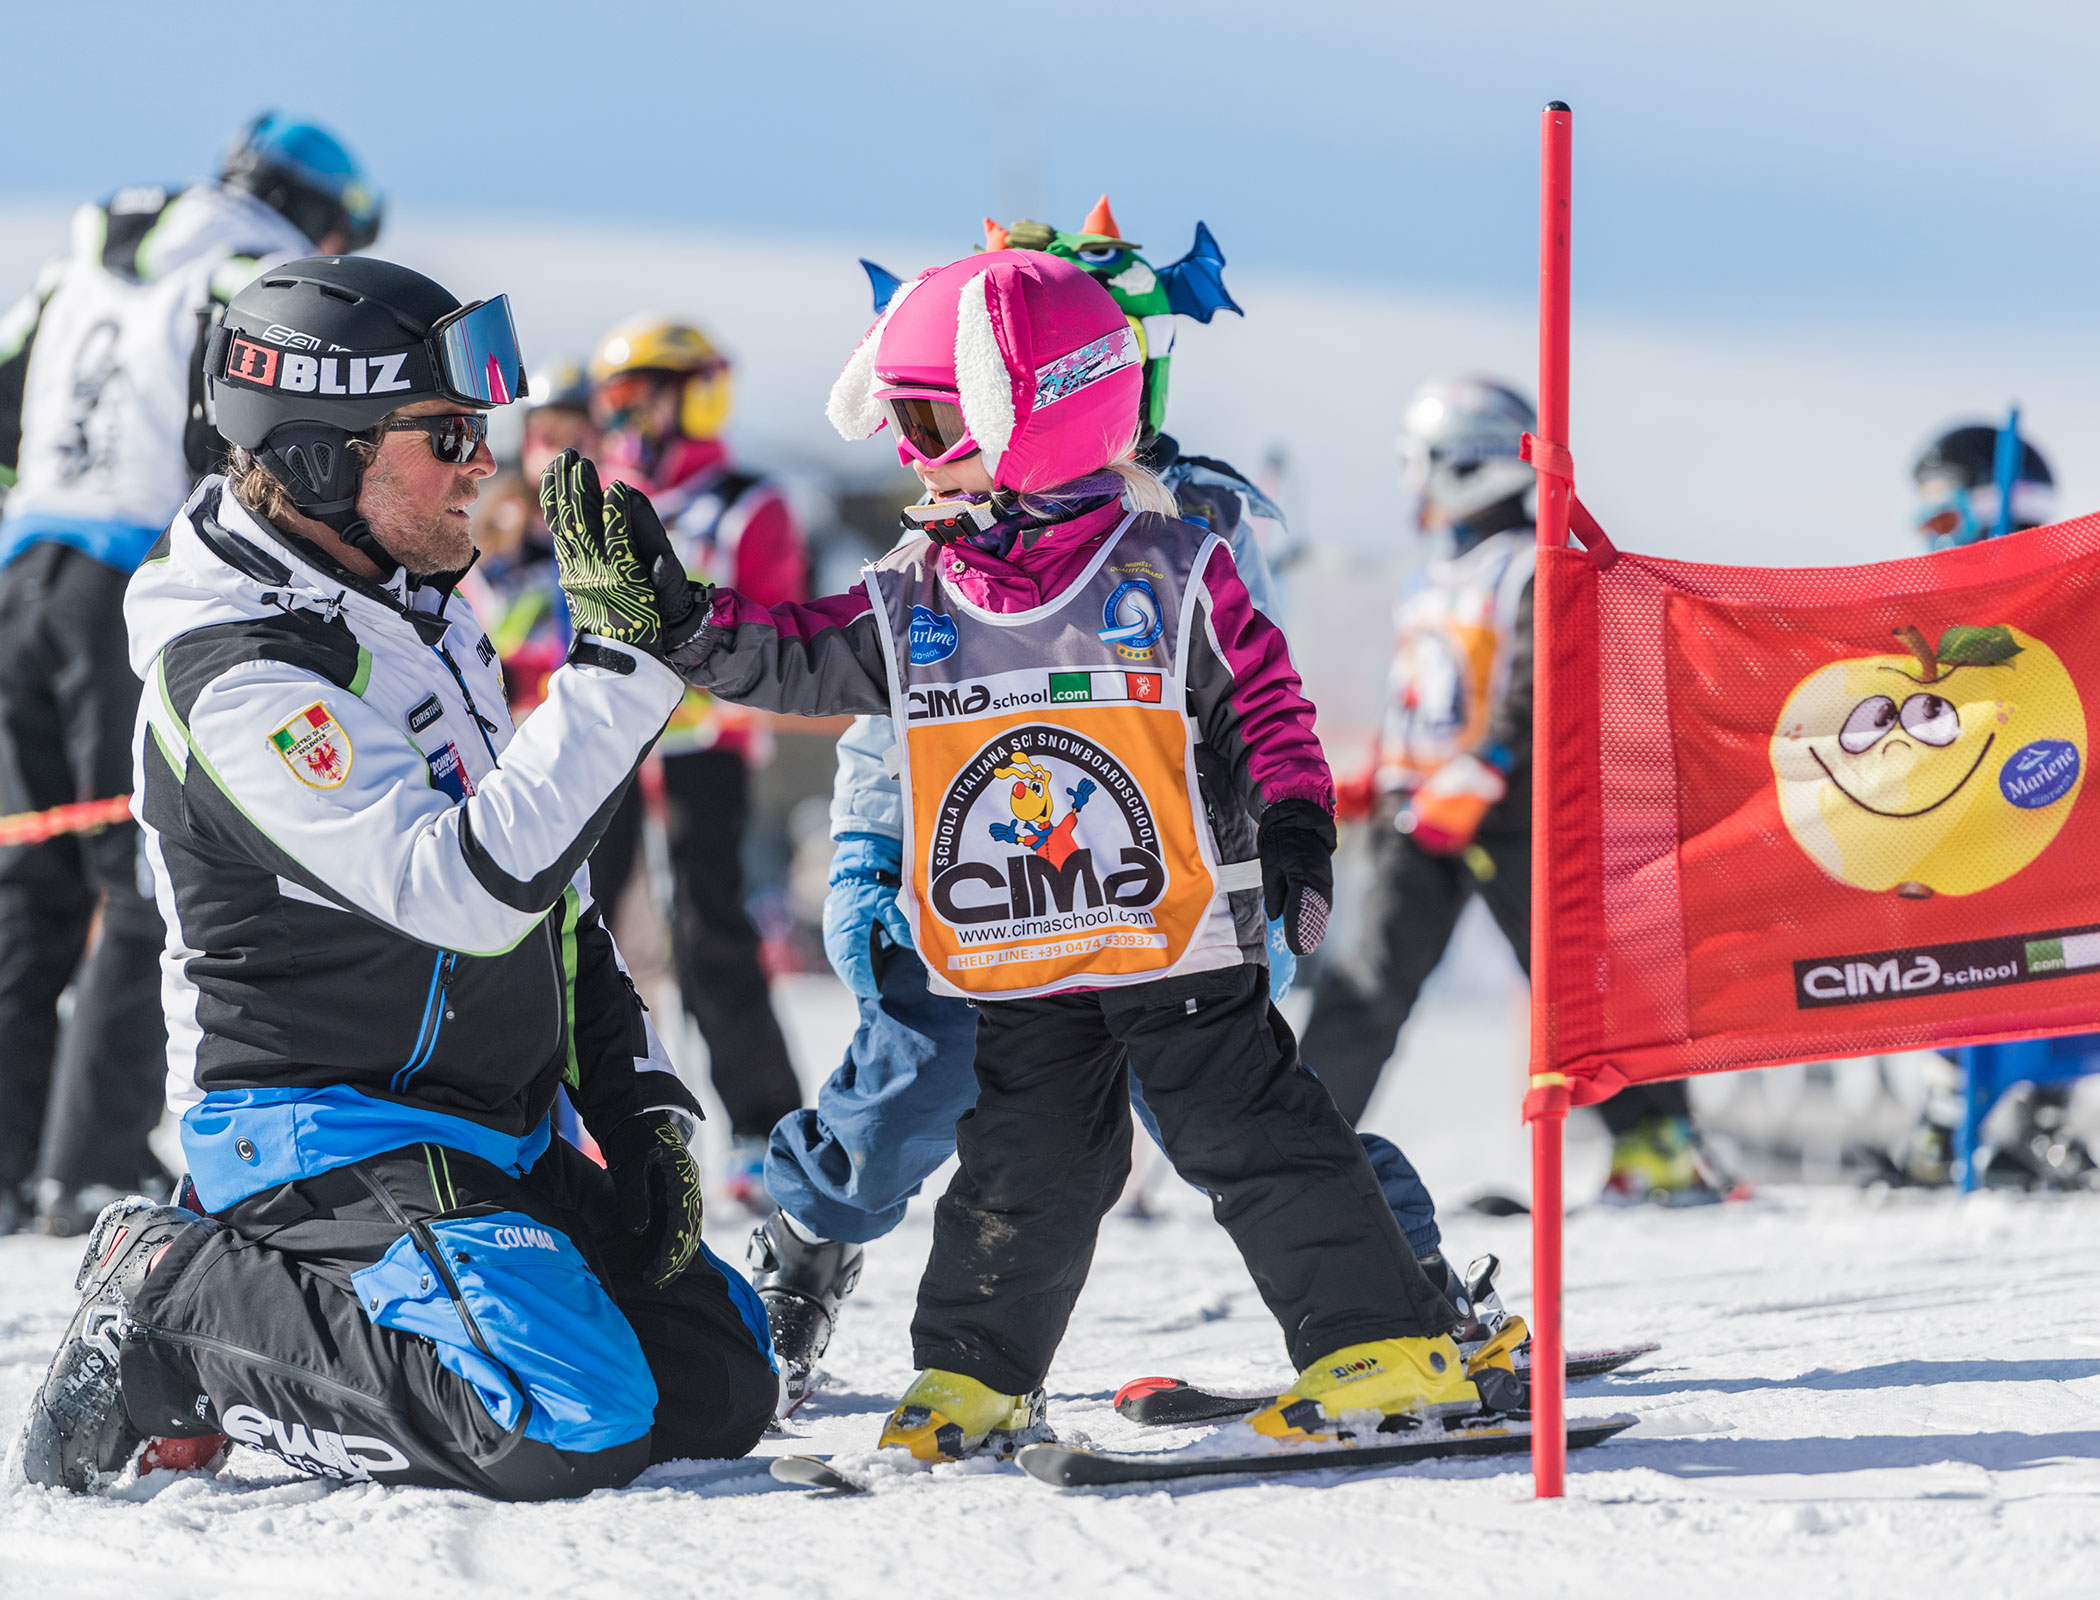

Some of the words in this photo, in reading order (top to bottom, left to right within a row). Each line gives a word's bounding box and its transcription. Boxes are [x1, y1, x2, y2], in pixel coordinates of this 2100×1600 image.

[280, 352, 411, 395] BLIZ
[1140, 567, 1164, 579] AWARD
[911, 626, 955, 646] arlene
[312, 729, 320, 737] DI
[320, 722, 331, 731] SCI
[2006, 747, 2076, 800] Marlene
[936, 805, 960, 866] SCUOLA
[953, 745, 1008, 802] ITALIANA
[1010, 734, 1033, 751] SCI
[1037, 733, 1155, 848] SNOWBOARDSCHOOL
[958, 907, 1154, 944] www.cimaschool.com
[958, 953, 995, 968] HELP
[998, 949, 1035, 963] LINE:
[1038, 945, 1062, 958] +39
[1066, 939, 1102, 954] 0474
[1105, 935, 1153, 947] 530937
[494, 1226, 560, 1252] COLMAR
